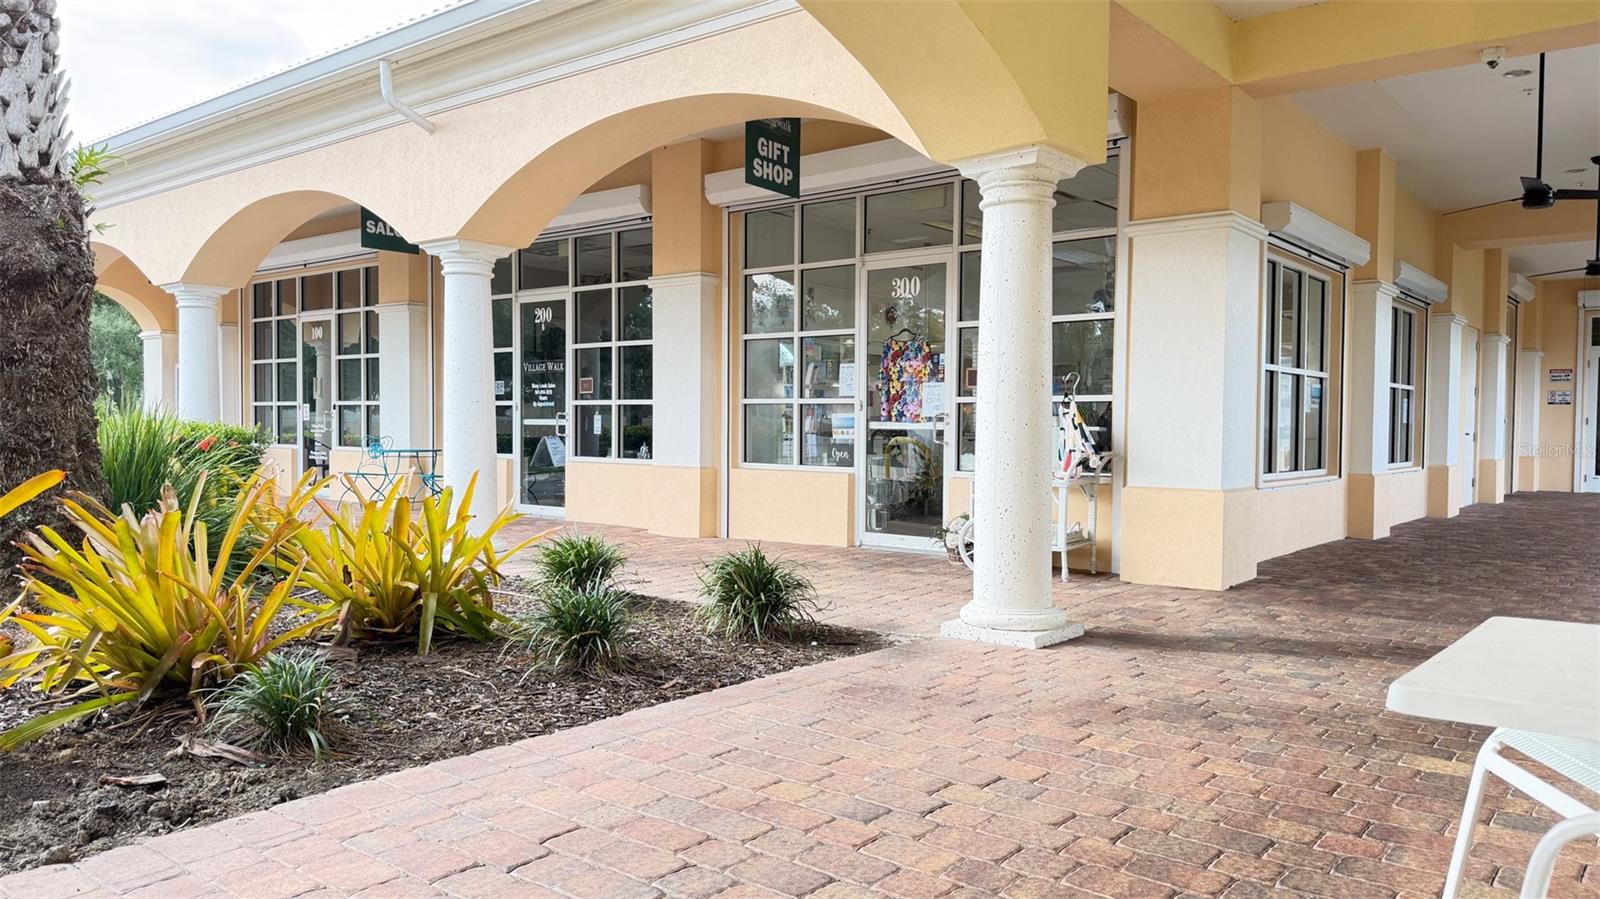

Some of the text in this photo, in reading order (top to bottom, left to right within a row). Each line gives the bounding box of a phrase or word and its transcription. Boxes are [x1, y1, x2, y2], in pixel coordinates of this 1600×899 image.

[757, 136, 790, 164] GIFT
[752, 157, 793, 186] SHOP
[891, 276, 920, 298] 300
[535, 307, 552, 323] 200
[312, 326, 323, 340] 100
[523, 361, 564, 372] VILLAGE WALK
[831, 447, 849, 462] Open
